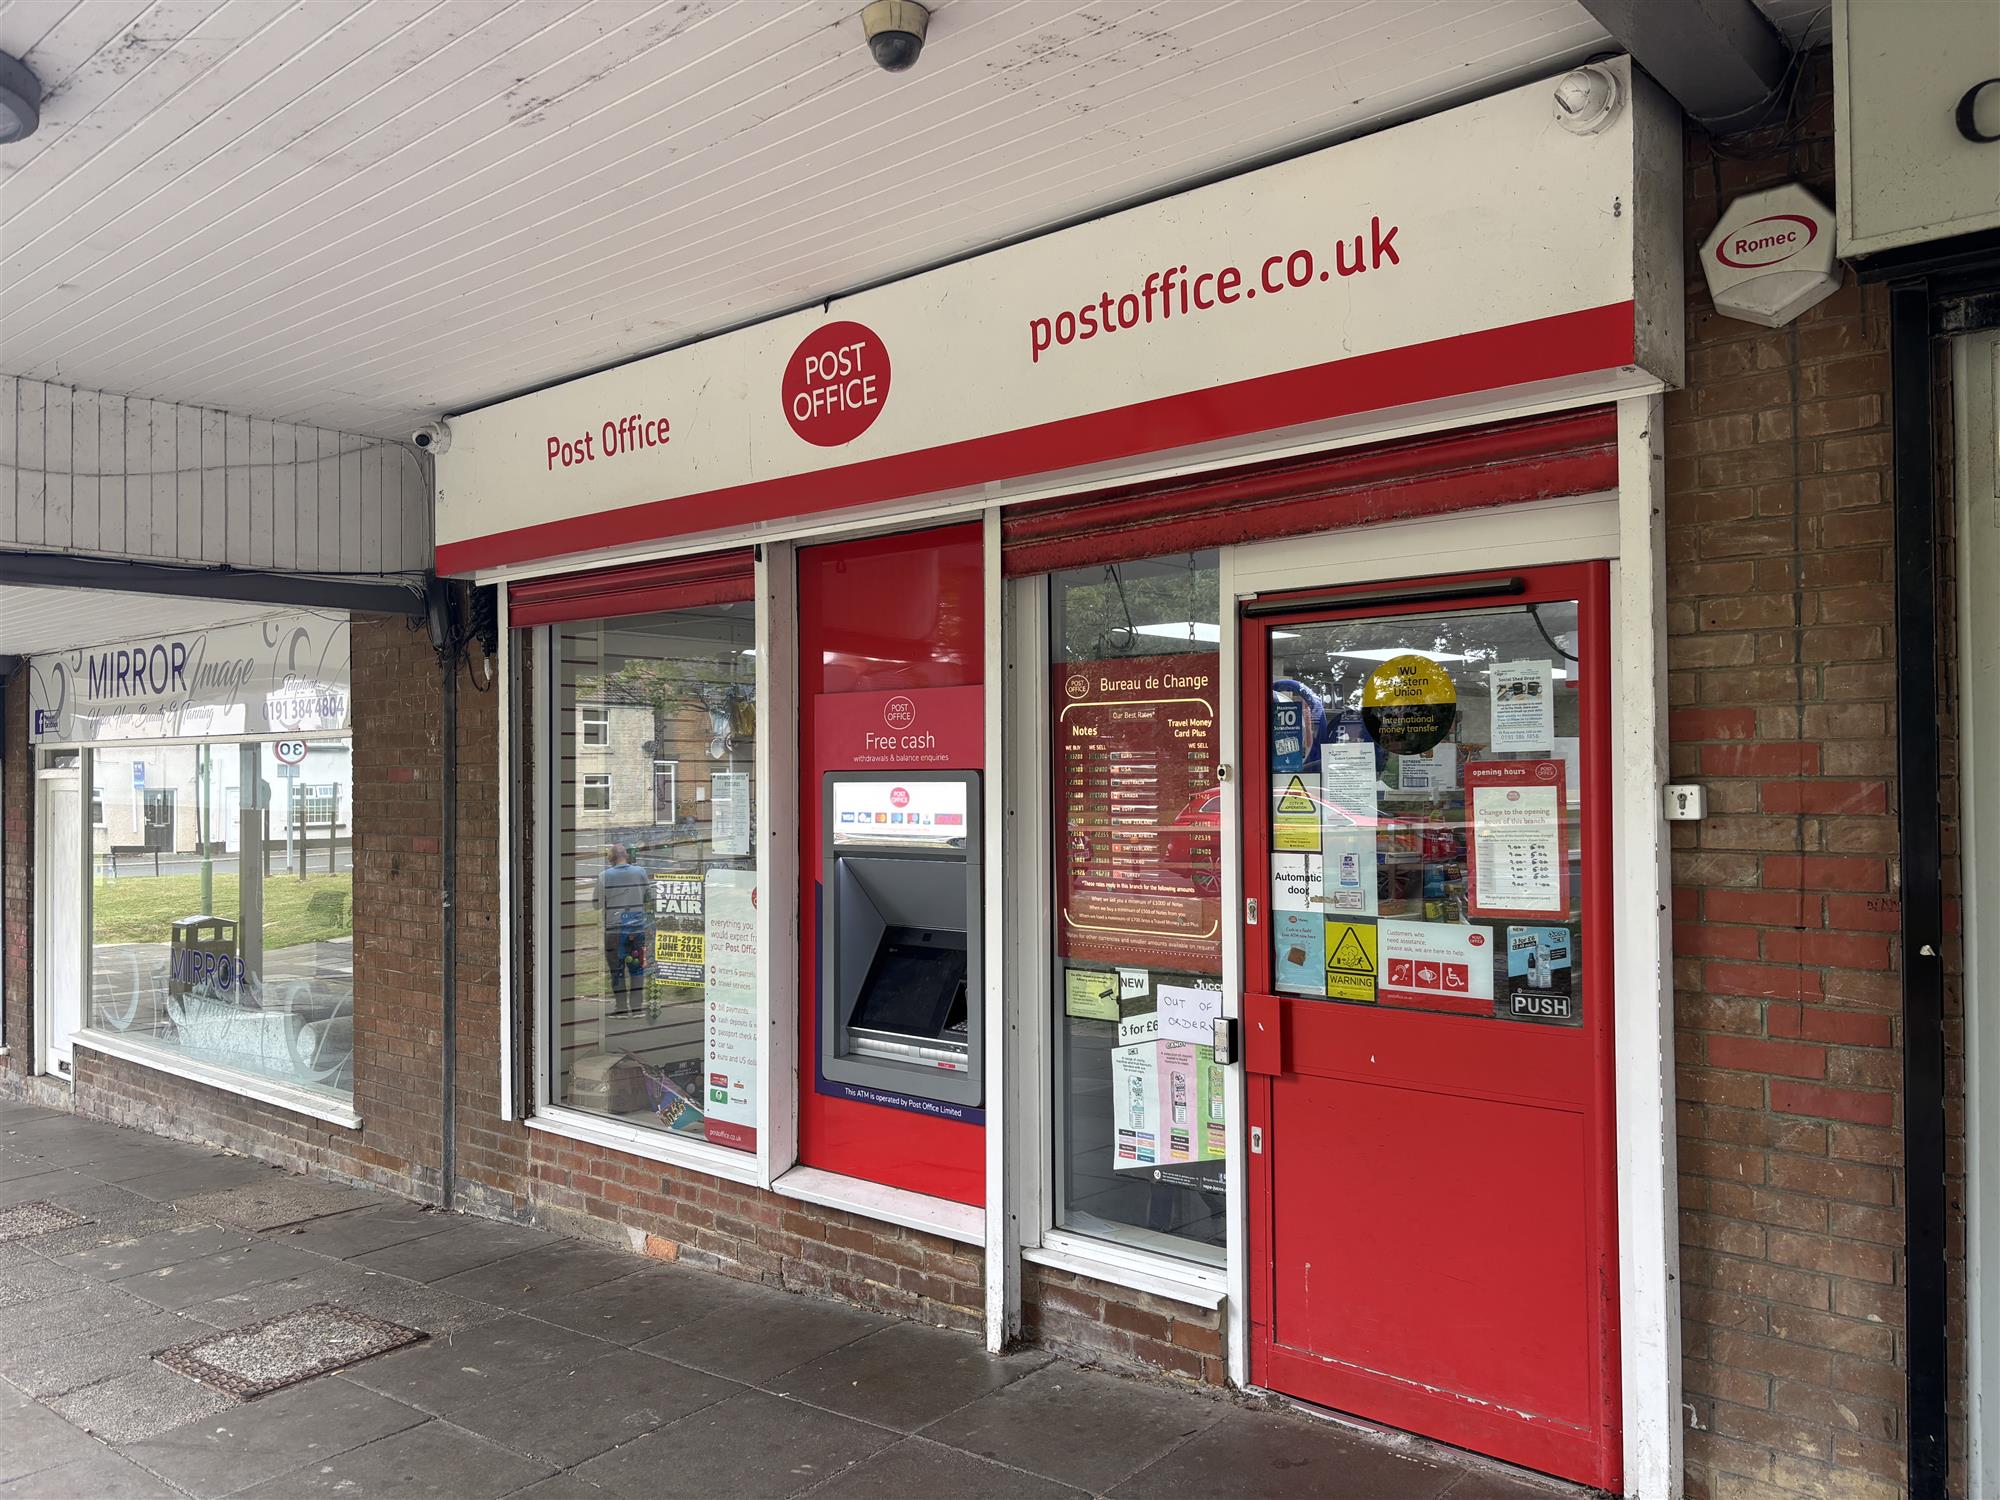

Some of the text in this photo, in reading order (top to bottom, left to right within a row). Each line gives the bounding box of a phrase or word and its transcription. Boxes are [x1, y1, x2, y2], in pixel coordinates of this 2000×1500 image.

[1734, 231, 1797, 255] Romec
[1029, 215, 1401, 364] postoffice.co.uk
[804, 341, 867, 386] POST
[792, 374, 878, 422] OFFICE
[546, 413, 671, 471] Post Office
[88, 634, 254, 716] MIRROR Image
[1399, 666, 1417, 675] WU
[1070, 679, 1085, 687] POST
[1100, 674, 1209, 692] Bureau de Change
[1068, 685, 1087, 694] OFFICE
[1393, 687, 1423, 697] Union
[262, 696, 345, 721] 0191 384 4804
[891, 703, 909, 712] POST
[887, 712, 911, 721] OFFICE
[1124, 711, 1137, 719] Best
[1277, 710, 1297, 726] 10
[1382, 714, 1434, 724] International
[1167, 718, 1213, 729] Travel Money
[1072, 725, 1098, 737] Notes
[1174, 729, 1207, 738] Card Plus
[1378, 725, 1439, 735] money transfer
[865, 731, 935, 750] Free cash
[853, 755, 889, 763] withdrawals
[895, 753, 920, 762] balance
[920, 753, 950, 763] enquiries
[1472, 768, 1502, 777] opening
[1478, 808, 1503, 817] Change
[1504, 808, 1511, 816] to
[1523, 808, 1551, 817] opening
[1523, 817, 1546, 825] branch
[1275, 872, 1322, 883] Automatic
[655, 880, 702, 895] STEAM
[1157, 884, 1176, 893] following
[1287, 886, 1310, 895] door
[664, 893, 702, 901] VINTAGE
[655, 899, 703, 914] FAIR
[710, 919, 754, 931] everything you
[656, 934, 703, 944] 28TH-29TH
[710, 931, 729, 940] would
[729, 934, 749, 943] expect
[1386, 929, 1413, 938] Customers
[656, 943, 703, 953] JUNE 2025
[710, 943, 725, 952] your
[725, 942, 740, 953] Post
[685, 952, 703, 960] PARK
[171, 946, 246, 994] MIRROR
[1120, 977, 1144, 989] NEW
[1329, 974, 1373, 988] WARNING
[1163, 996, 1213, 1011] OUT OF
[1514, 996, 1567, 1016] PUSH
[1121, 1020, 1159, 1037] 3 for £6
[1168, 1017, 1208, 1031] ORDER
[718, 1029, 738, 1039] passport
[739, 1030, 752, 1040] check
[726, 1042, 734, 1050] tax
[1165, 1041, 1186, 1050] CANDY
[717, 1054, 728, 1062] euro
[728, 1055, 738, 1064] and
[739, 1056, 747, 1065] US
[845, 1087, 962, 1117] This ATM is operated by Post Office Limited
[709, 1128, 742, 1142] postoffice.co.uk
